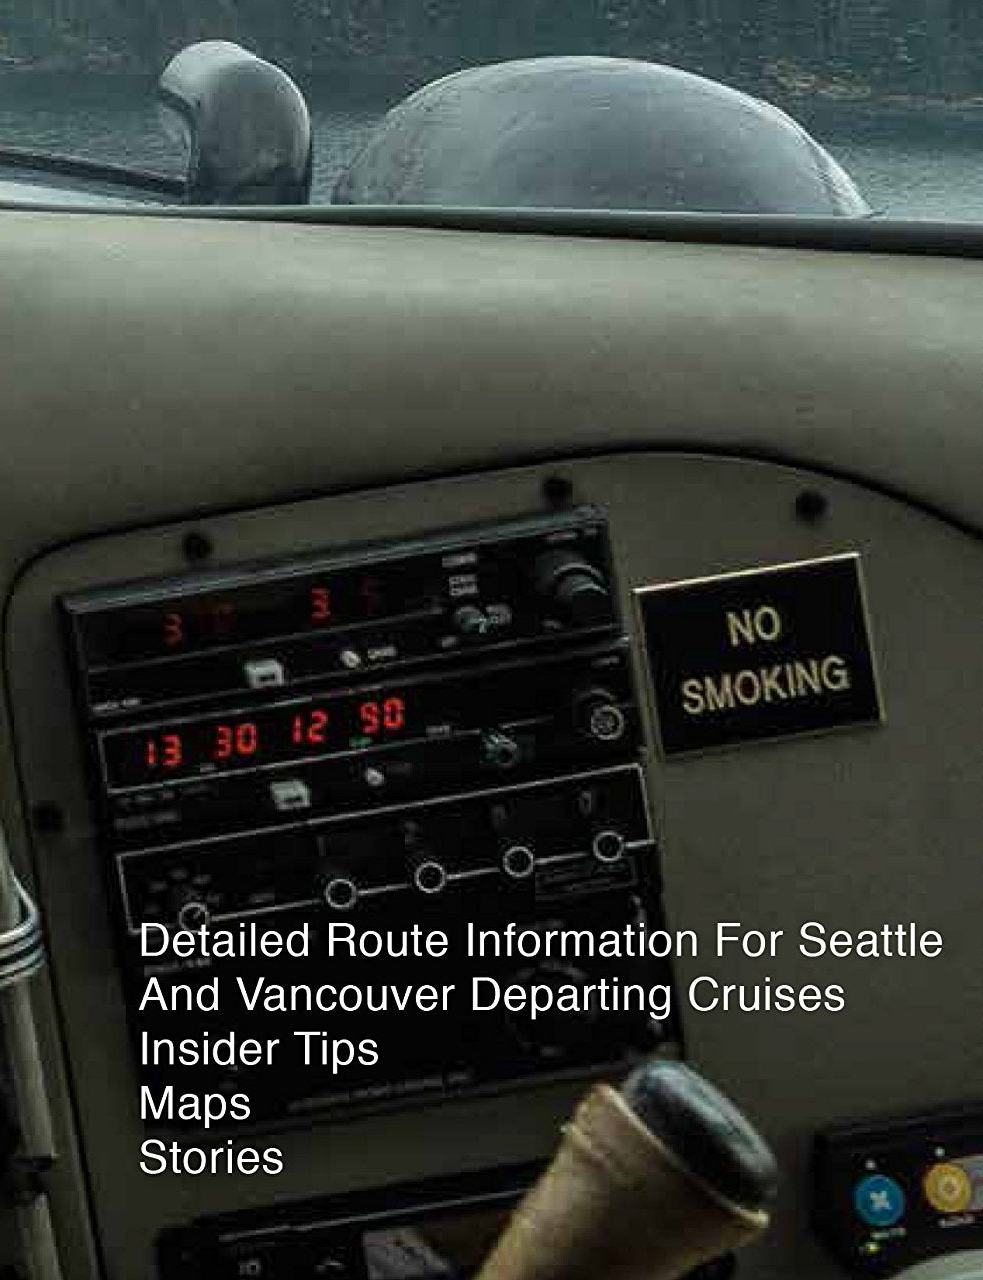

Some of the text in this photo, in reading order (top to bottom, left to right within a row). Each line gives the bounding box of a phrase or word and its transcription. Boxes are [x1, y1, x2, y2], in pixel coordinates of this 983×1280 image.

[726, 606, 781, 647] NO
[681, 656, 851, 715] SMOKING
[145, 734, 183, 767] 13
[216, 723, 258, 757] 30
[292, 711, 329, 744] 12
